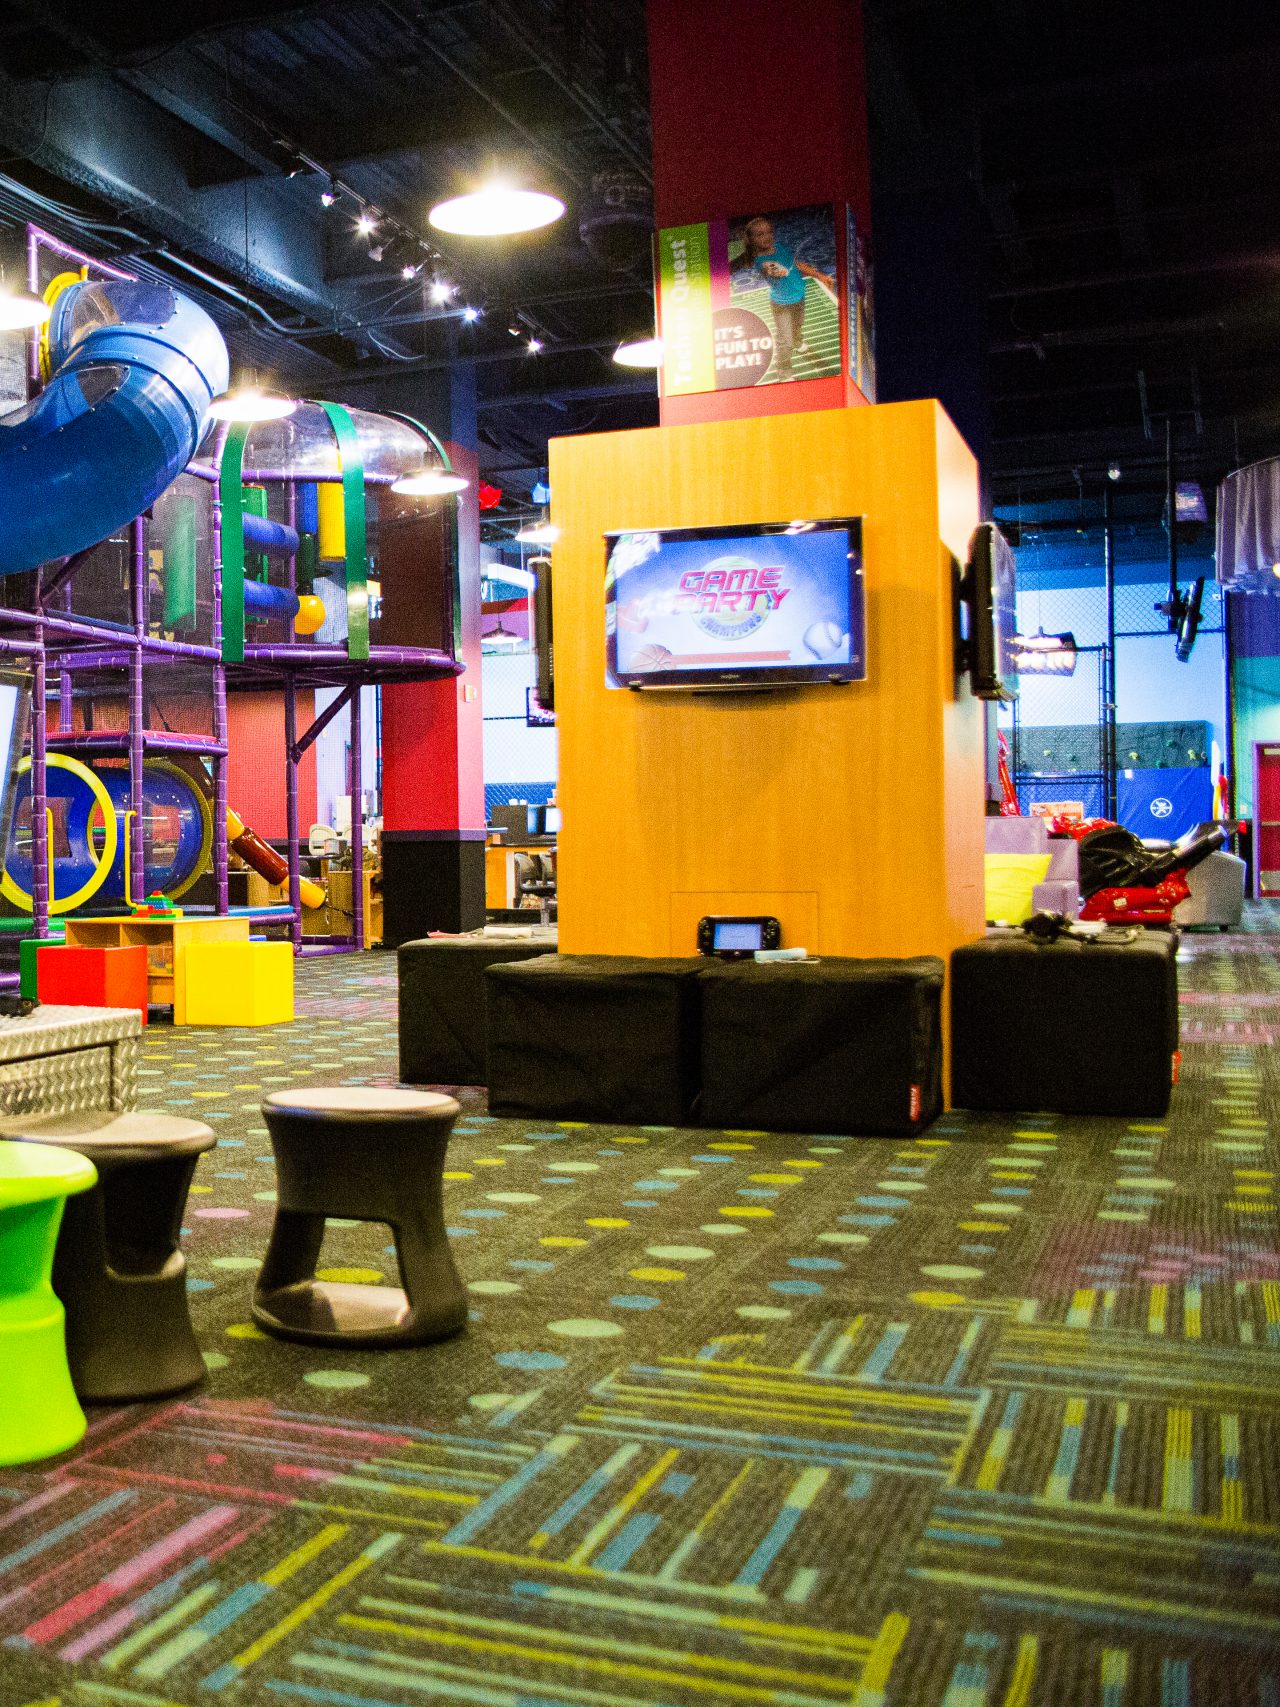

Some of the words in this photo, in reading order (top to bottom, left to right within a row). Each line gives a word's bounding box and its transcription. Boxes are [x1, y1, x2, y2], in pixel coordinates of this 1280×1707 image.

[670, 240, 689, 304] Quest
[714, 326, 744, 341] IT'S
[715, 341, 749, 355] FUN
[750, 337, 772, 351] TO
[715, 352, 763, 371] PLAY!
[680, 567, 783, 592] GAME
[672, 587, 792, 616] PARTY
